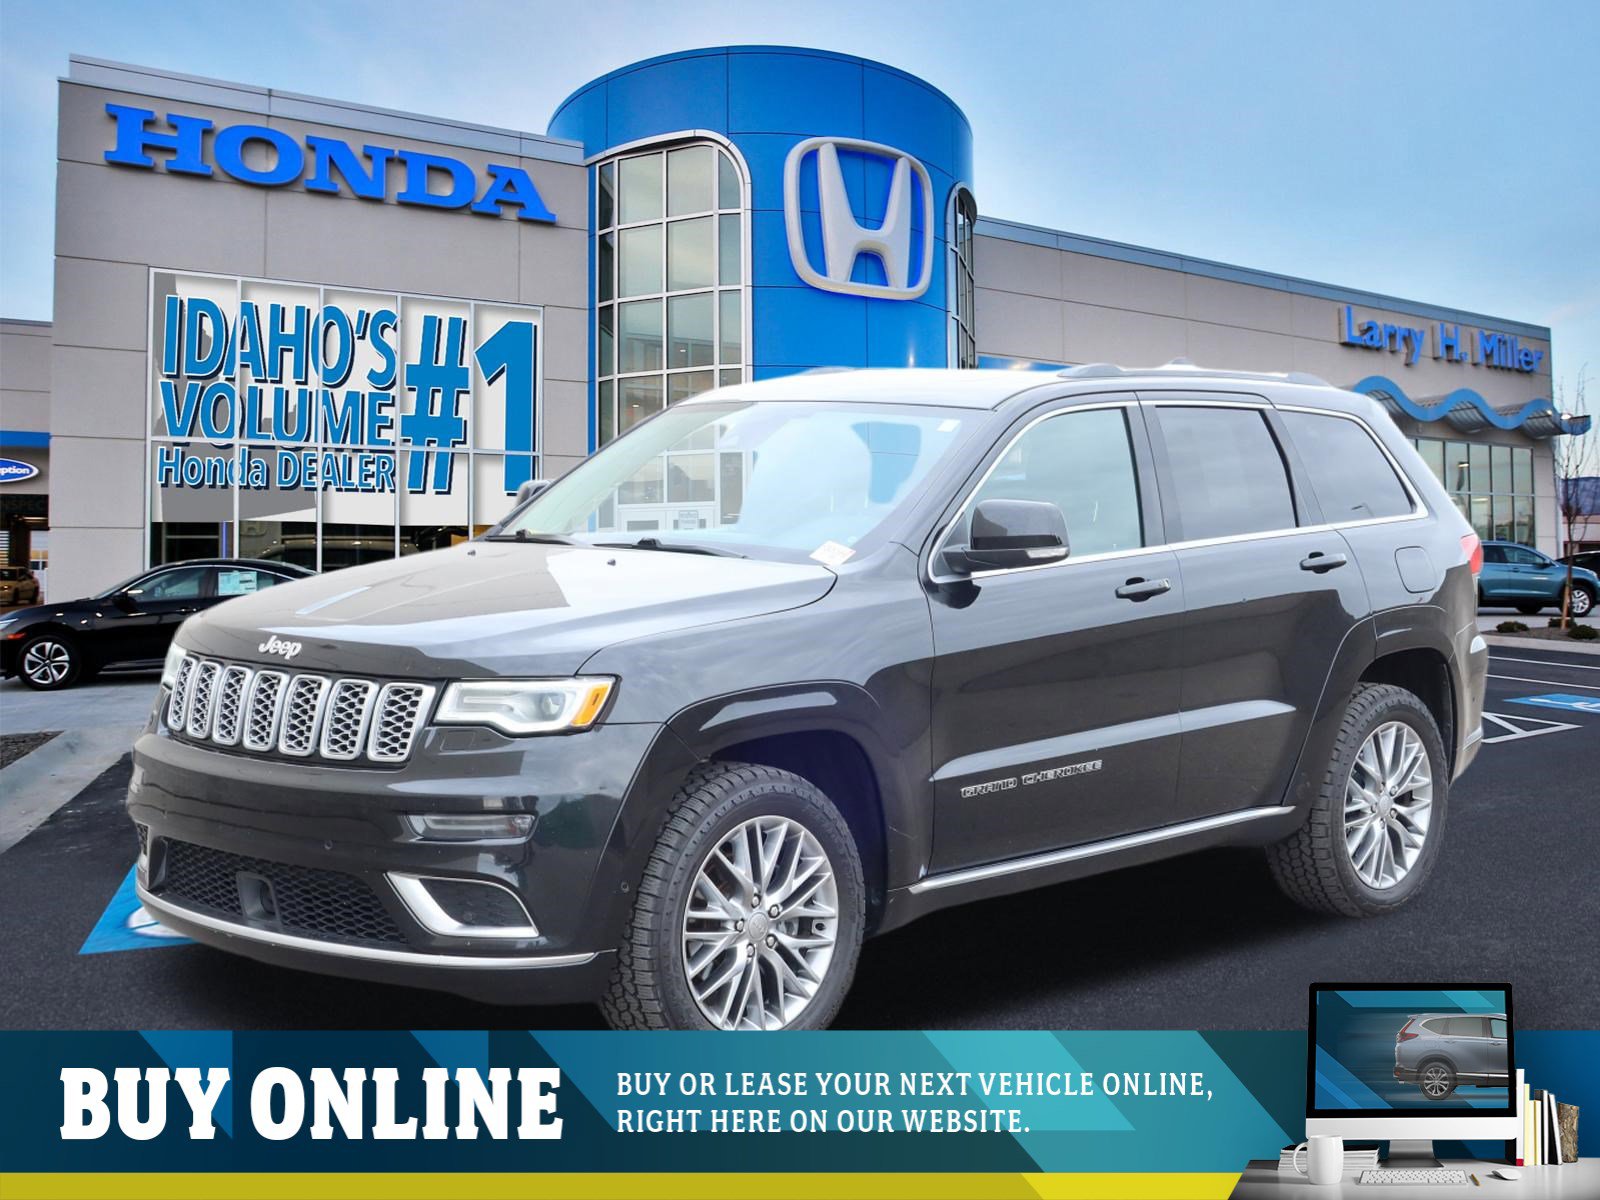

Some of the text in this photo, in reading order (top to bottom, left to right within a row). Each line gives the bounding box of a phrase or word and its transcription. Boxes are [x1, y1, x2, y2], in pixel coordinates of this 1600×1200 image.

[104, 103, 558, 223] HONDA
[161, 294, 398, 392] IDAHO'S
[1344, 304, 1545, 372] Larry H. Miller
[159, 379, 396, 452] VOLUME
[400, 314, 538, 496] #1
[0, 466, 30, 476] ption
[157, 446, 396, 494] Honda DEALER
[258, 635, 302, 660] Jeep
[960, 759, 1103, 798] GRAND CHEROKEE
